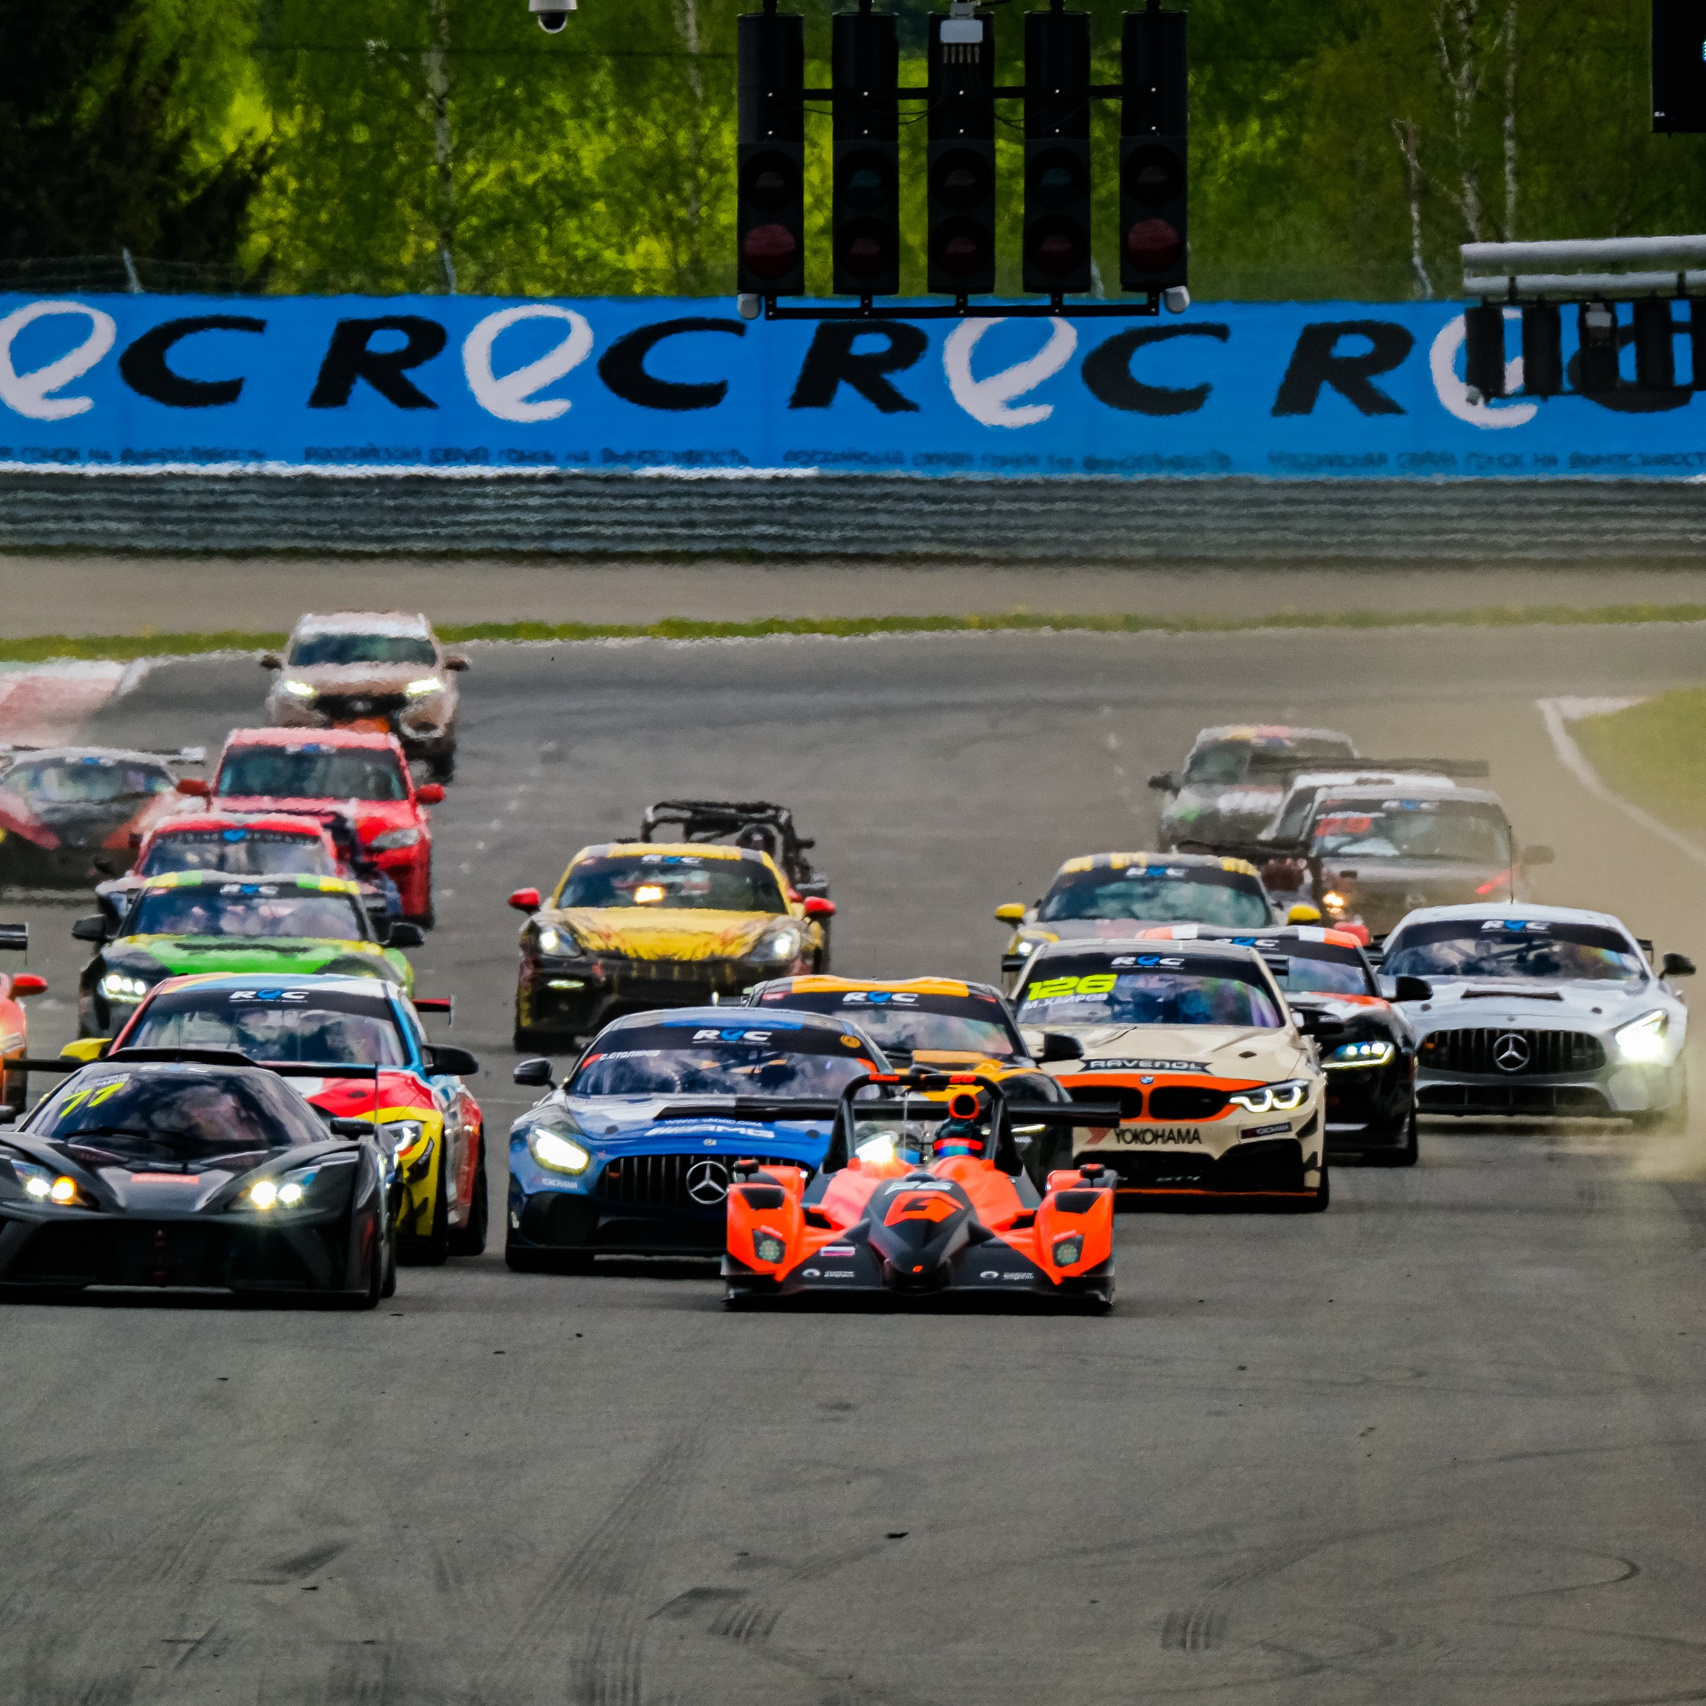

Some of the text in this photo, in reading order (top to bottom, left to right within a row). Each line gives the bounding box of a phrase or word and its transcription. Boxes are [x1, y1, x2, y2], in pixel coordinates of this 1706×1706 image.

[1027, 973, 1118, 1001] 126
[1089, 1060, 1201, 1071] RAVENOL
[1115, 1128, 1202, 1145] YOKOHAMA
